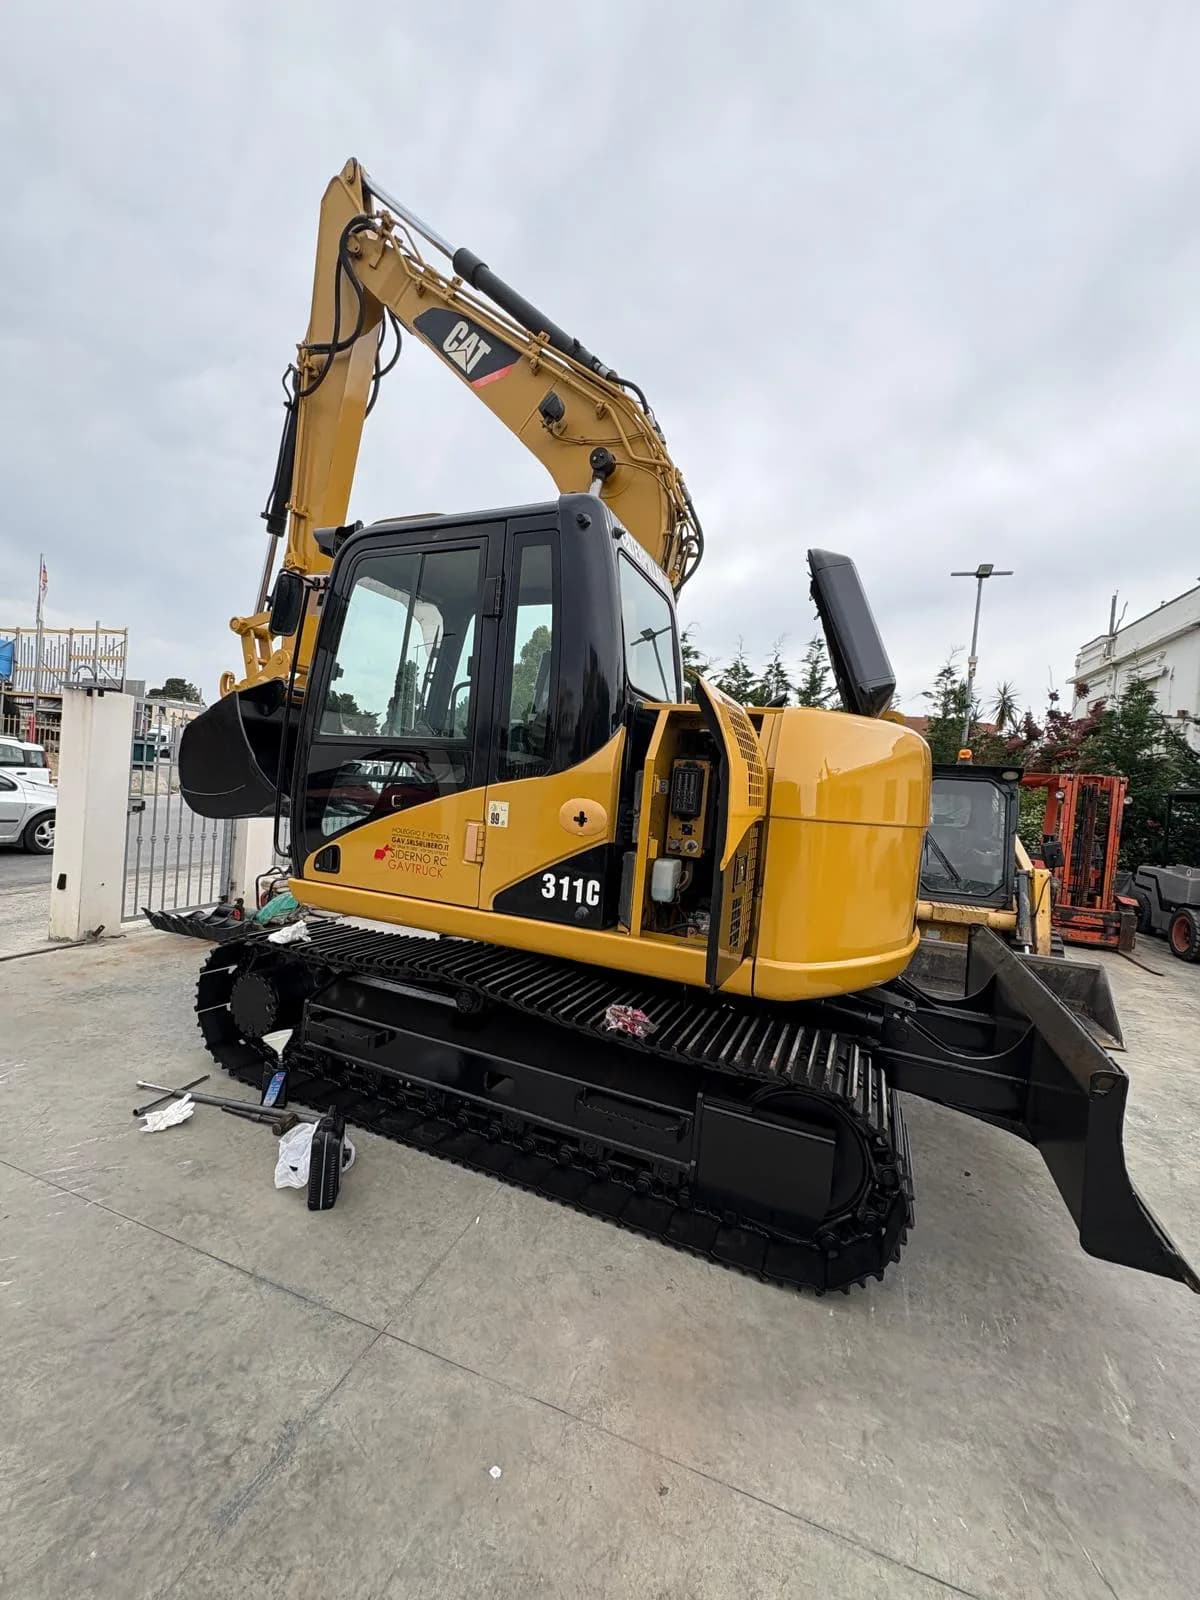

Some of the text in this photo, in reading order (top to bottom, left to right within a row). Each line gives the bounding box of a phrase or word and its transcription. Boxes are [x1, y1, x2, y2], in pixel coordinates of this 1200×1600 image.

[443, 320, 492, 374] CAT
[490, 812, 500, 825] 99
[427, 832, 450, 841] VENDITA
[390, 848, 431, 864] SIDERNO
[433, 855, 448, 867] RC
[387, 859, 443, 878] GAVTRUCK
[541, 872, 600, 906] 311C
